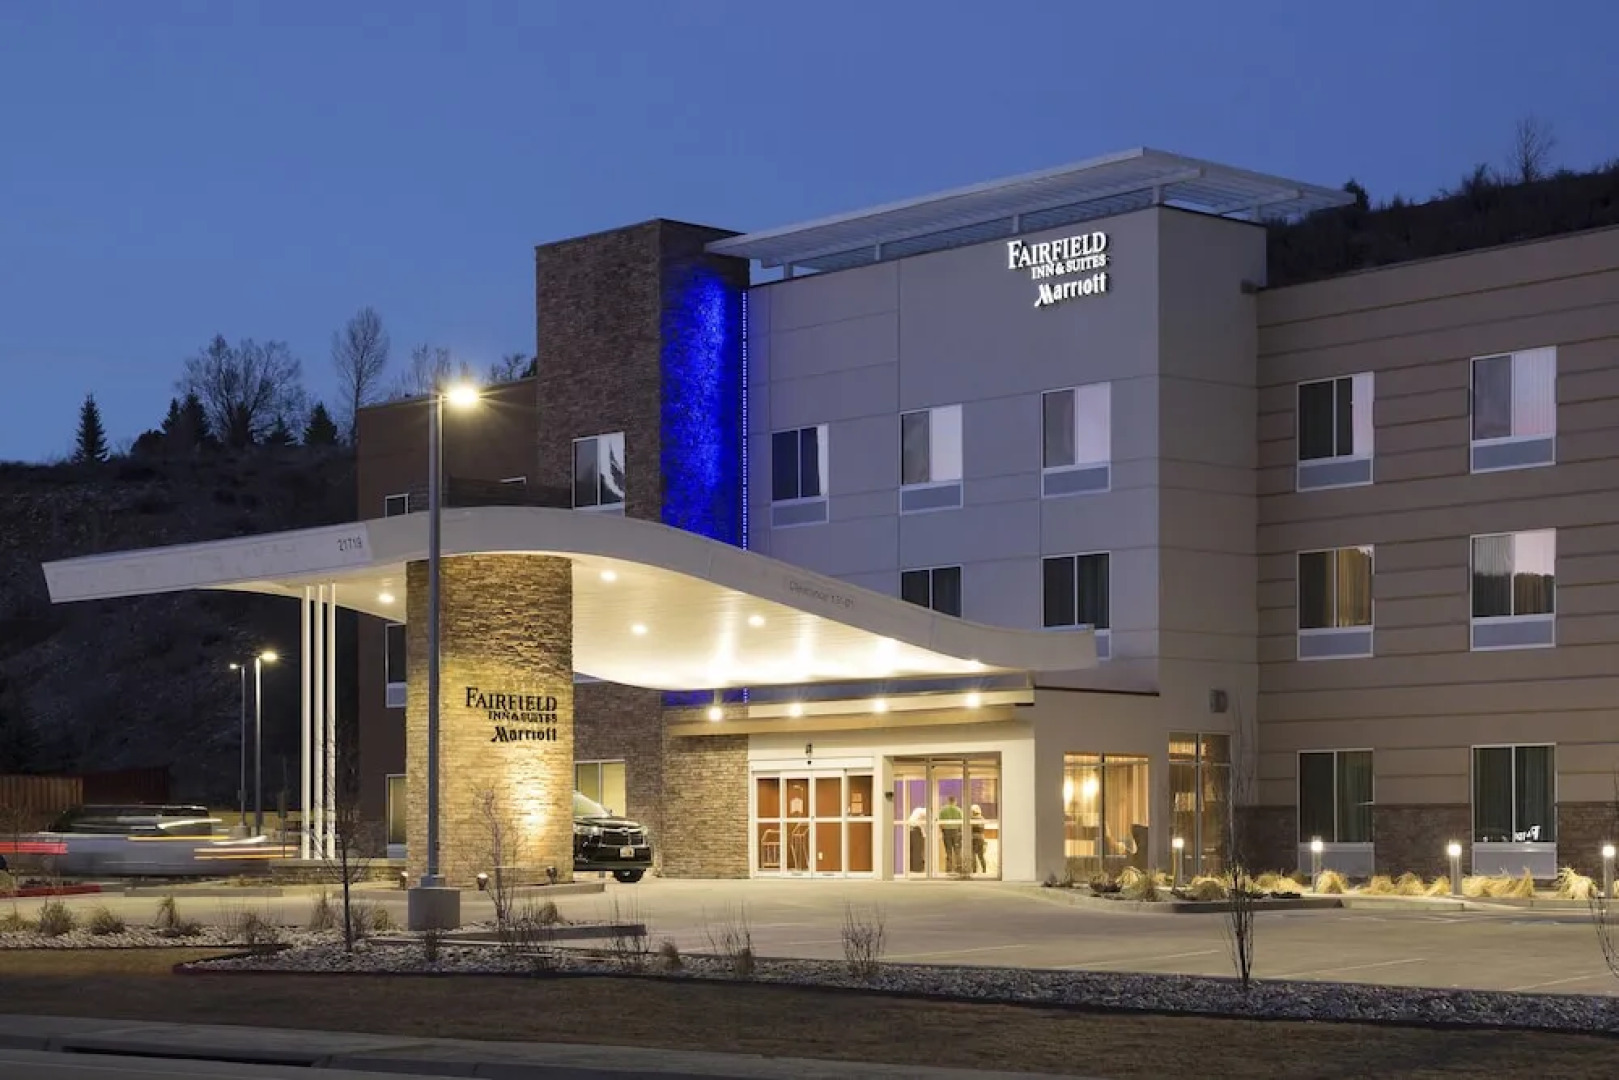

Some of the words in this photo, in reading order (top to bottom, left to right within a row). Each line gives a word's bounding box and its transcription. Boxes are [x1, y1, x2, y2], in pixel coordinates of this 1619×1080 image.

[1007, 231, 1106, 269] FAIRFIELD
[1031, 264, 1054, 279] INN
[1055, 262, 1065, 275] &
[1066, 254, 1106, 273] SUITES
[1033, 272, 1106, 308] Marriott
[466, 686, 557, 711] FAIRFIELD
[489, 711, 510, 720] INN
[521, 712, 557, 723] SUITES
[490, 726, 556, 742] Marriott
